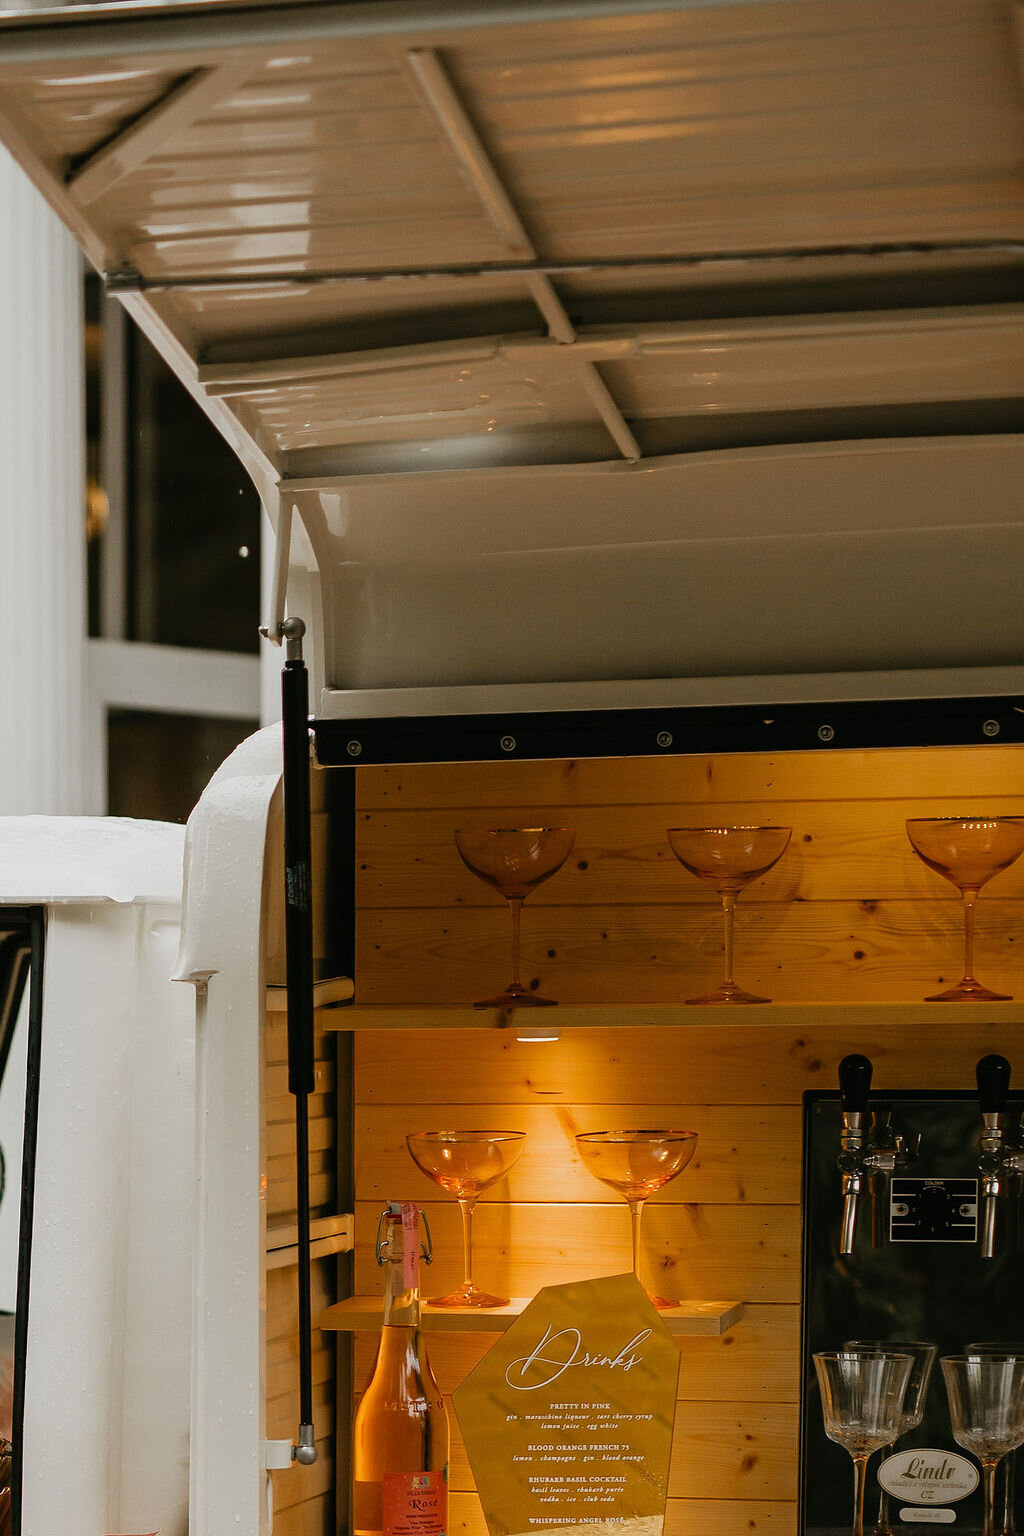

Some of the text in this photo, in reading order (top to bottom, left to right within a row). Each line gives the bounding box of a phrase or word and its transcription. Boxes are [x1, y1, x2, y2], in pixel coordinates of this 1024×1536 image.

[505, 1323, 653, 1391] Drinks
[506, 1413, 518, 1421] gin
[565, 1413, 589, 1421] liqueur
[612, 1413, 632, 1421] cherry
[635, 1413, 654, 1421] syrup
[900, 1457, 956, 1480] Lindr
[920, 1490, 935, 1499] CZ
[605, 1516, 625, 1524] ROSÉ
